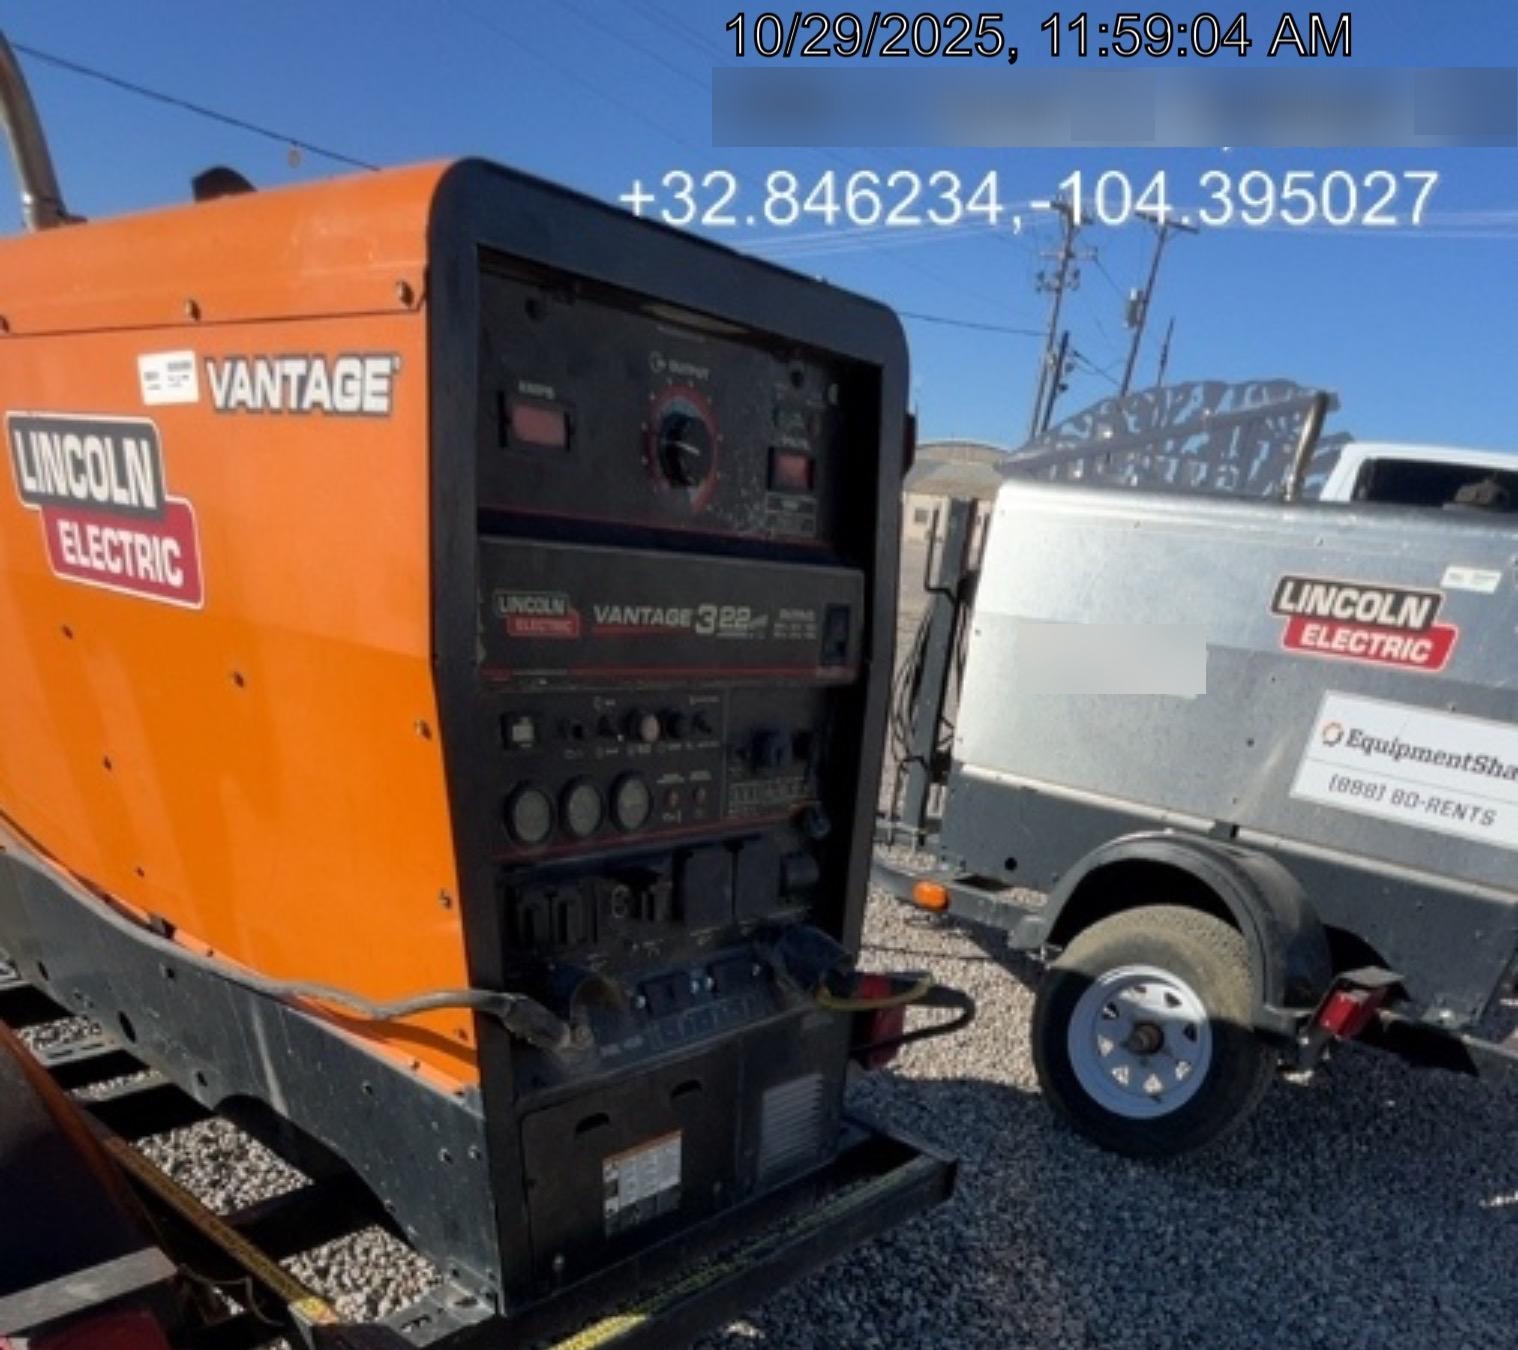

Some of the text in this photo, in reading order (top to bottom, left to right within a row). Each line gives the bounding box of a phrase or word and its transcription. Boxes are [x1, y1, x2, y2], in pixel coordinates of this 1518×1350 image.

[206, 355, 395, 415] VANTAGE
[14, 430, 158, 510] LINCOLN
[57, 519, 185, 588] ELECTRIC
[1277, 581, 1432, 629] LINCOLN
[1299, 623, 1434, 663] ELECTRIC
